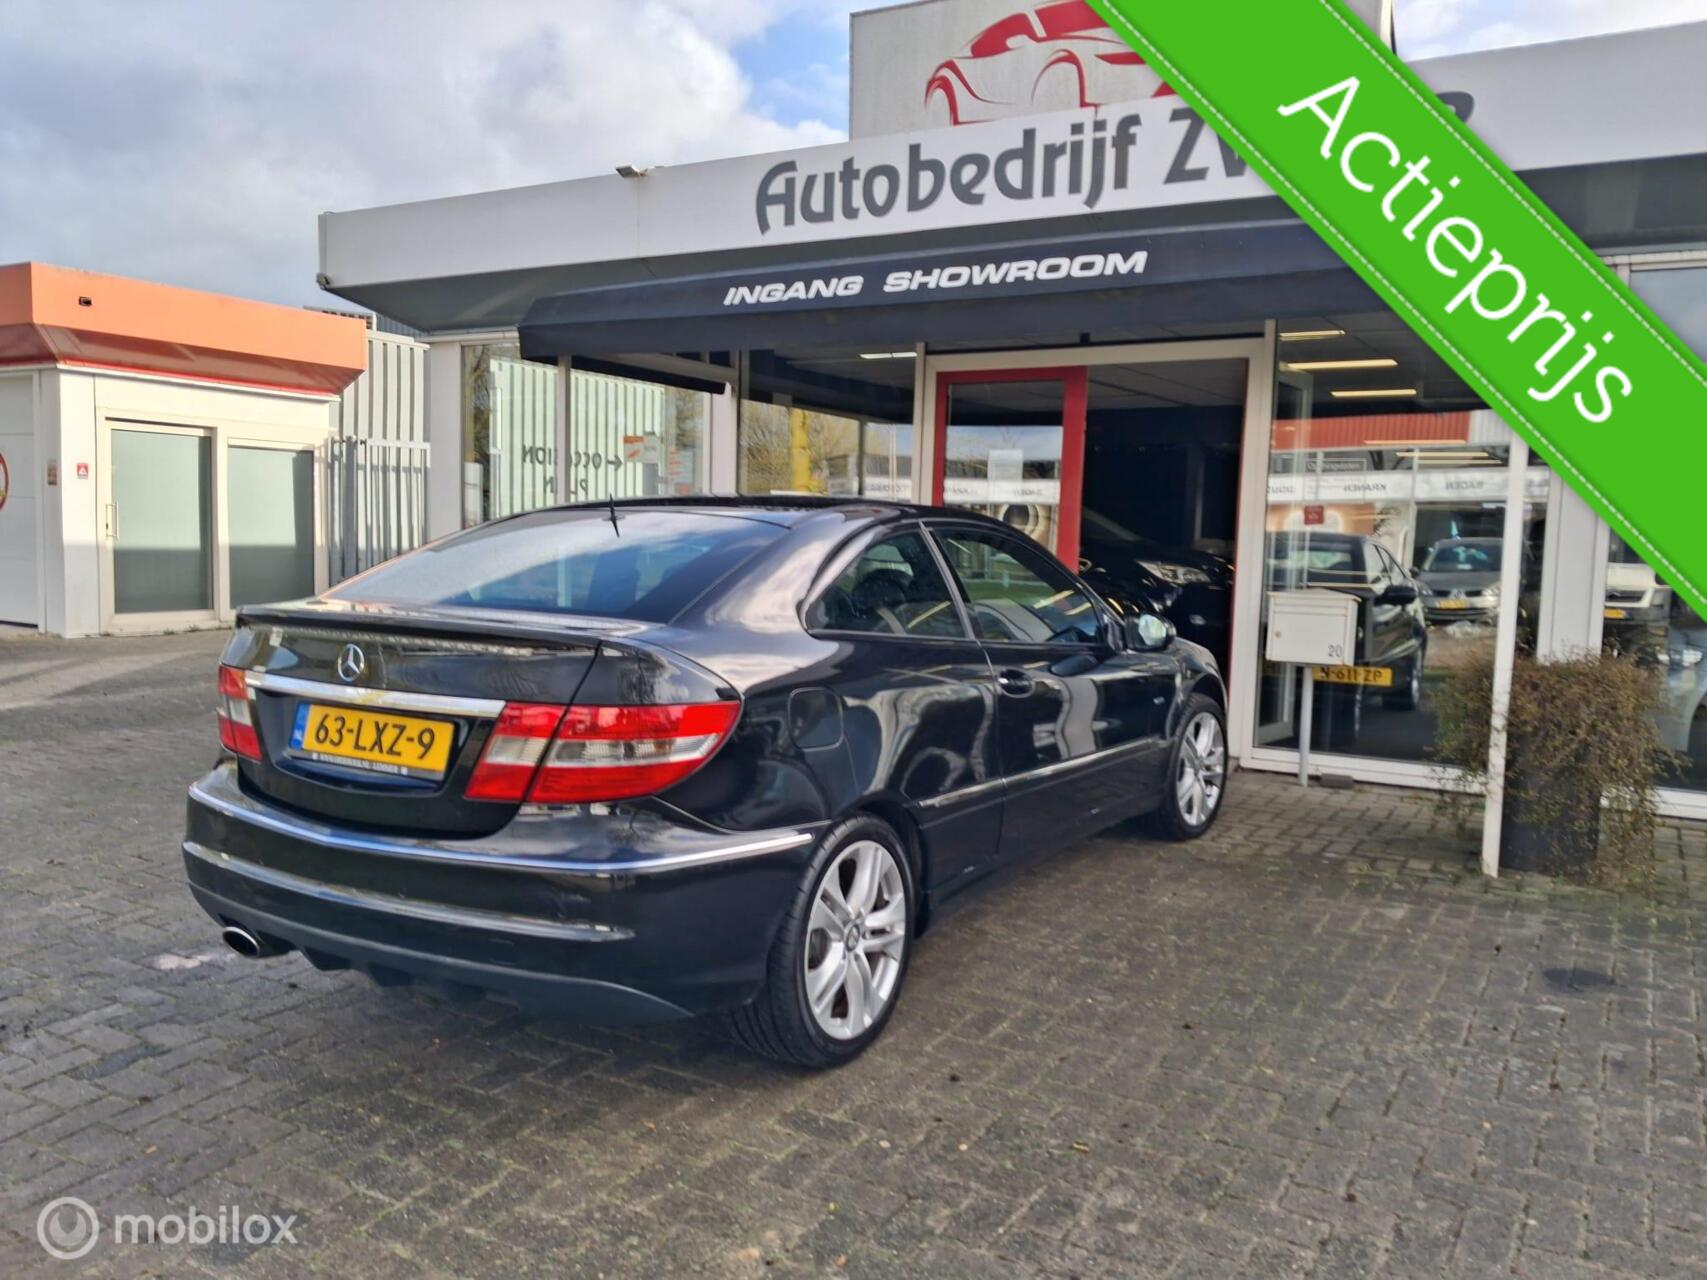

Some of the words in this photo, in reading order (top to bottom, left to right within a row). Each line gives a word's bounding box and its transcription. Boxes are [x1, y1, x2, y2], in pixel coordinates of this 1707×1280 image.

[756, 113, 1142, 235] Autobedrijf
[723, 275, 864, 306] INGANG
[883, 251, 1148, 293] SHOWROOM
[1327, 644, 1343, 658] 20
[315, 713, 436, 760] 63-LXZ-9
